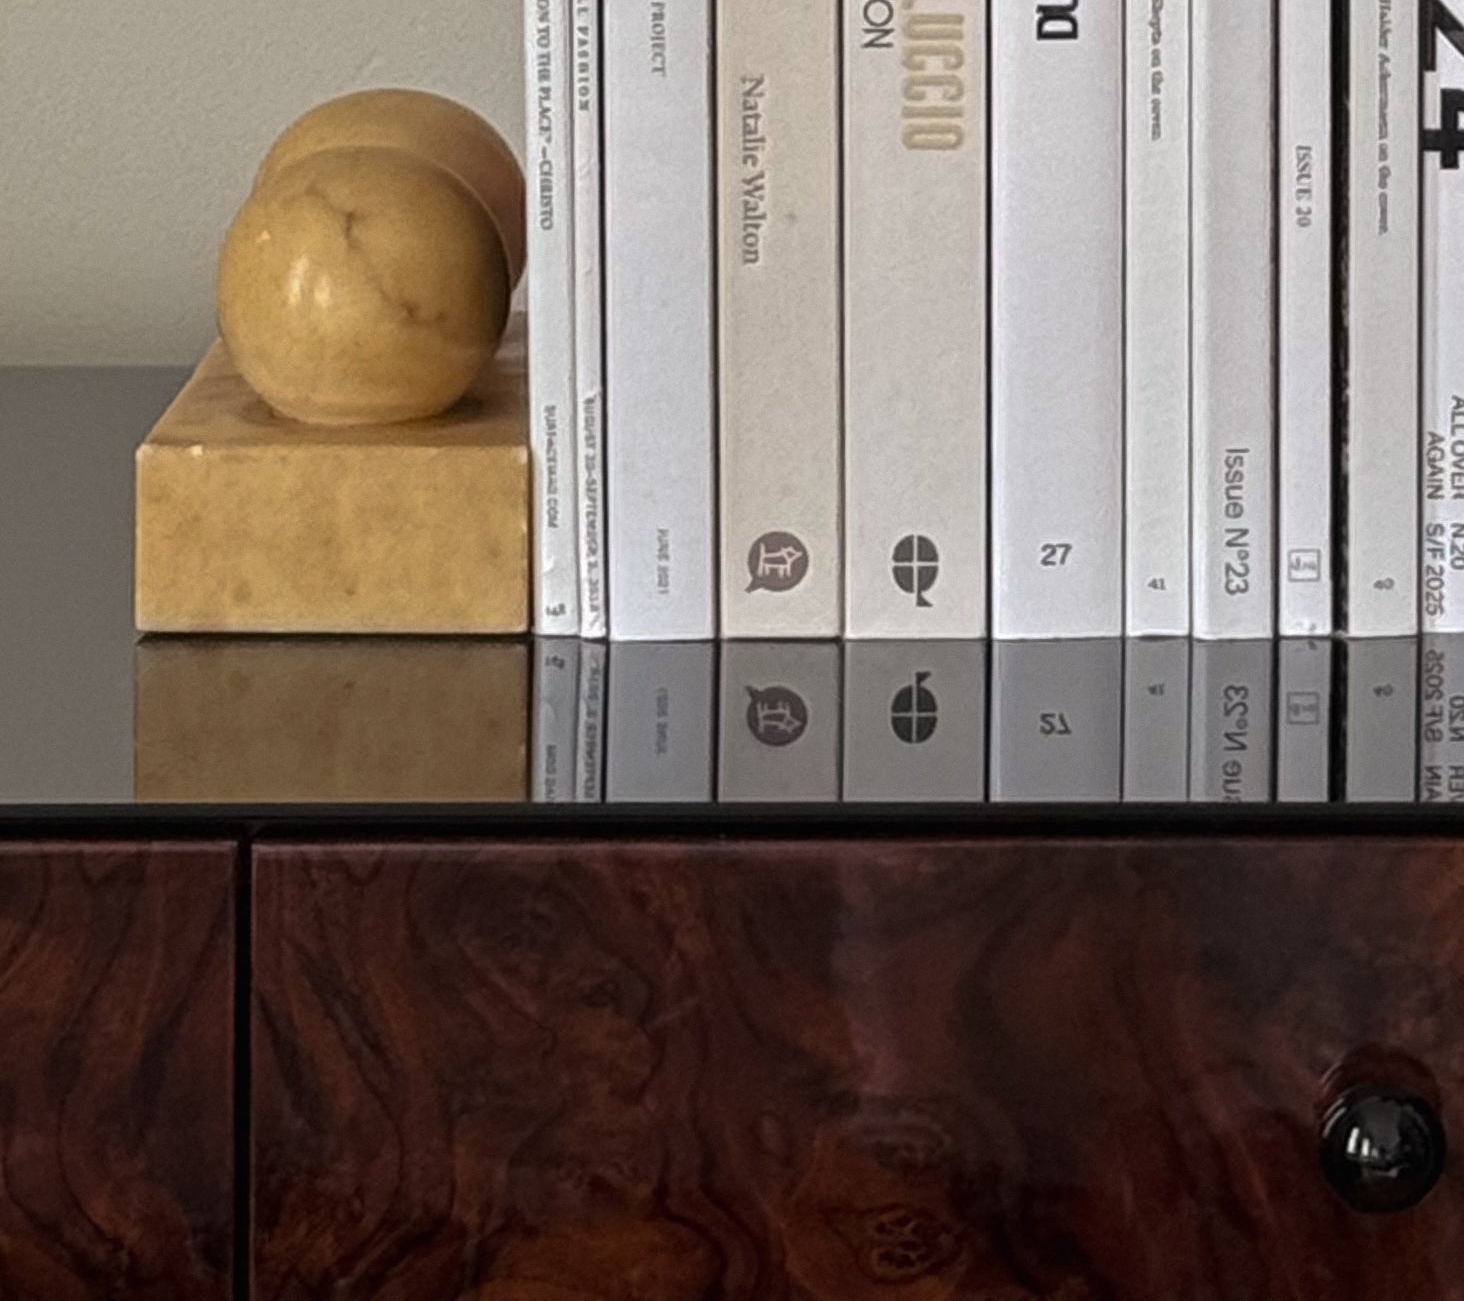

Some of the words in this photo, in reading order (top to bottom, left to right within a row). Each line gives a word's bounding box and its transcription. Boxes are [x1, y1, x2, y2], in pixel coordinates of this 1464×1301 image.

[536, 26, 551, 48] TO
[650, 2, 665, 77] PROJECT
[537, 53, 552, 82] THE
[740, 76, 765, 168] Natalie
[1296, 145, 1312, 202] ISSUE
[739, 169, 766, 265] Walton
[1296, 207, 1312, 228] 20
[1225, 448, 1249, 519] Issue
[1426, 431, 1444, 500] AGAIN
[1041, 544, 1072, 566] 27
[1426, 522, 1444, 560] S/F
[1426, 564, 1444, 616] 2025
